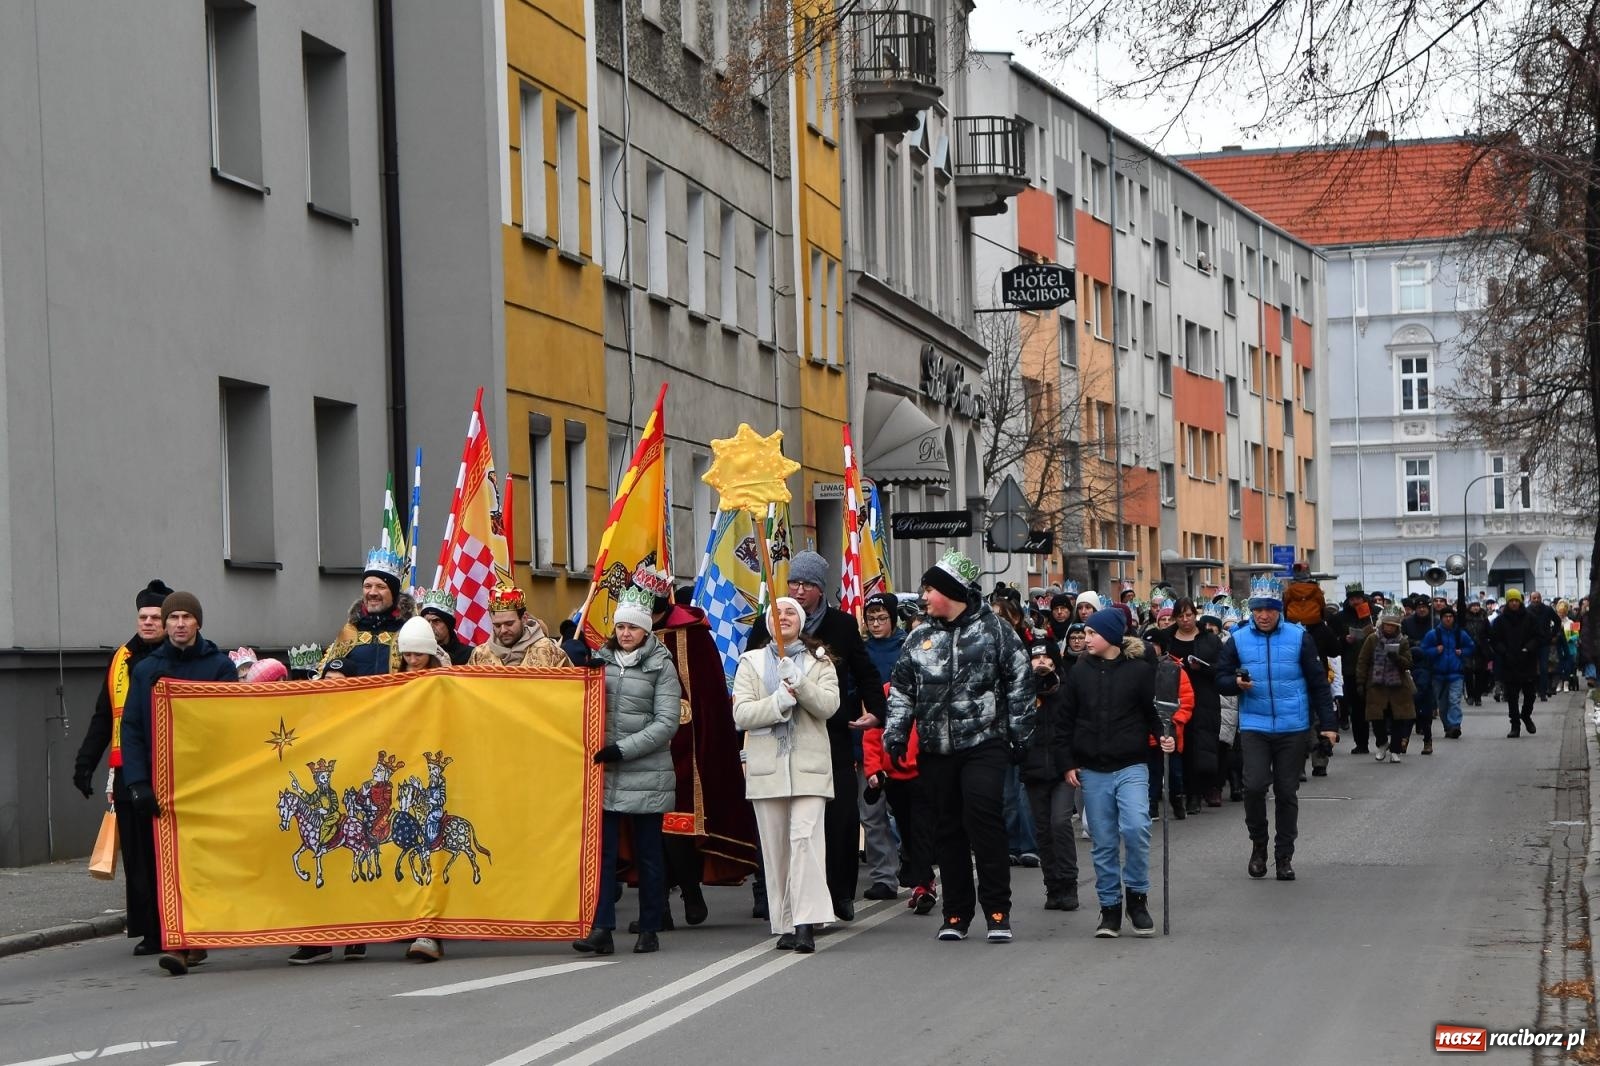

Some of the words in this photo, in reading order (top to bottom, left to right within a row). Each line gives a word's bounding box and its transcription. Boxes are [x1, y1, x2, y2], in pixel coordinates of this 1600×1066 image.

[1007, 287, 1070, 302] RACIBOR
[896, 518, 968, 535] Restauracja
[1024, 538, 1047, 549] tel
